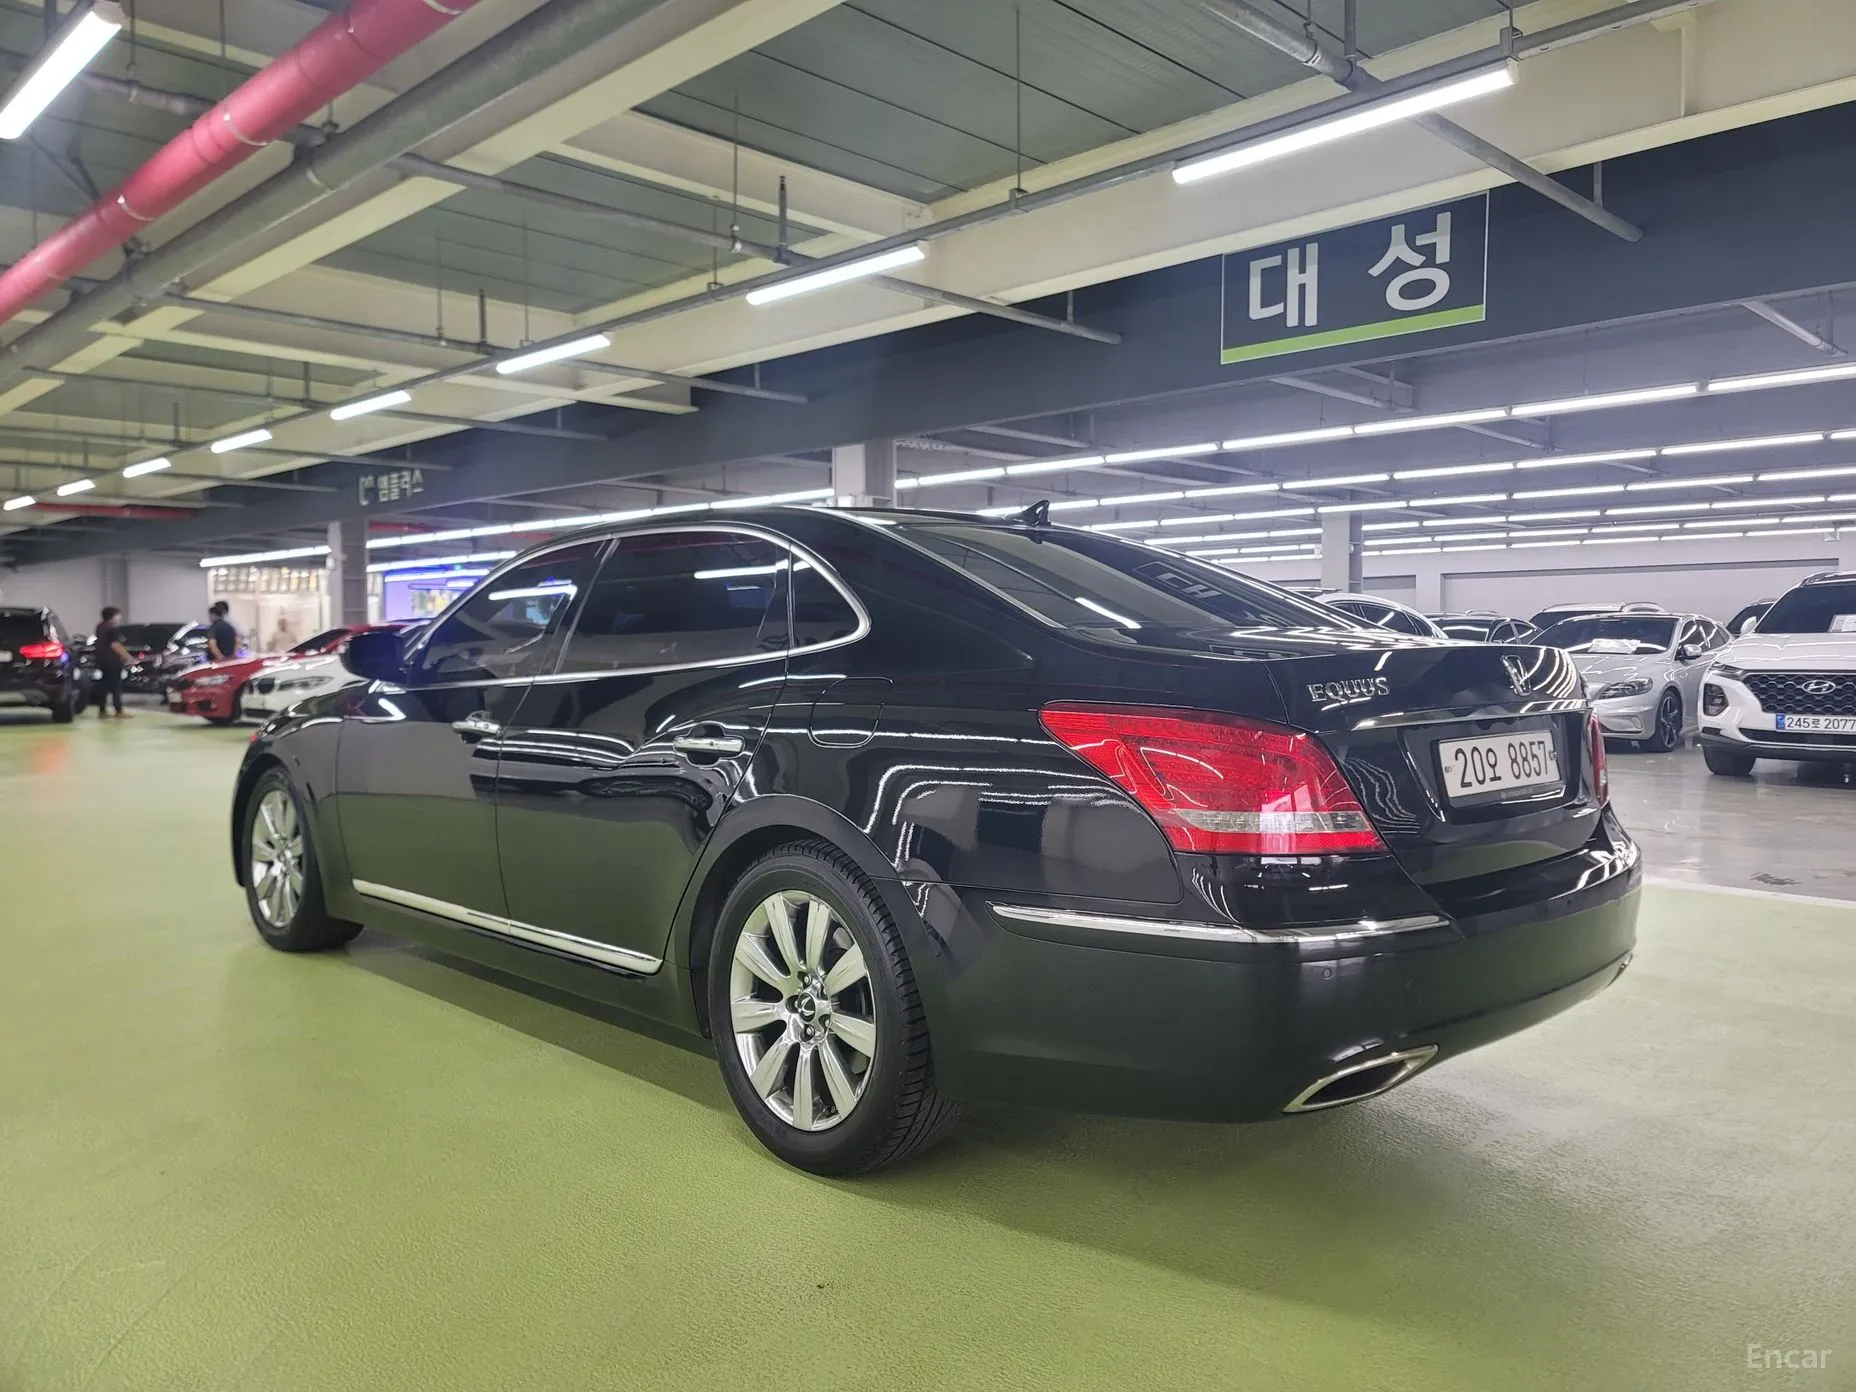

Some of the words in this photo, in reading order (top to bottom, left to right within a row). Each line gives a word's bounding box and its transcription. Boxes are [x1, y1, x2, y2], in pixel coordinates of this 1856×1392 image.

[1307, 677, 1390, 701] EQUUS
[1824, 718, 1856, 730] 2077
[1455, 746, 1502, 788] 20오
[1508, 740, 1549, 780] 8857
